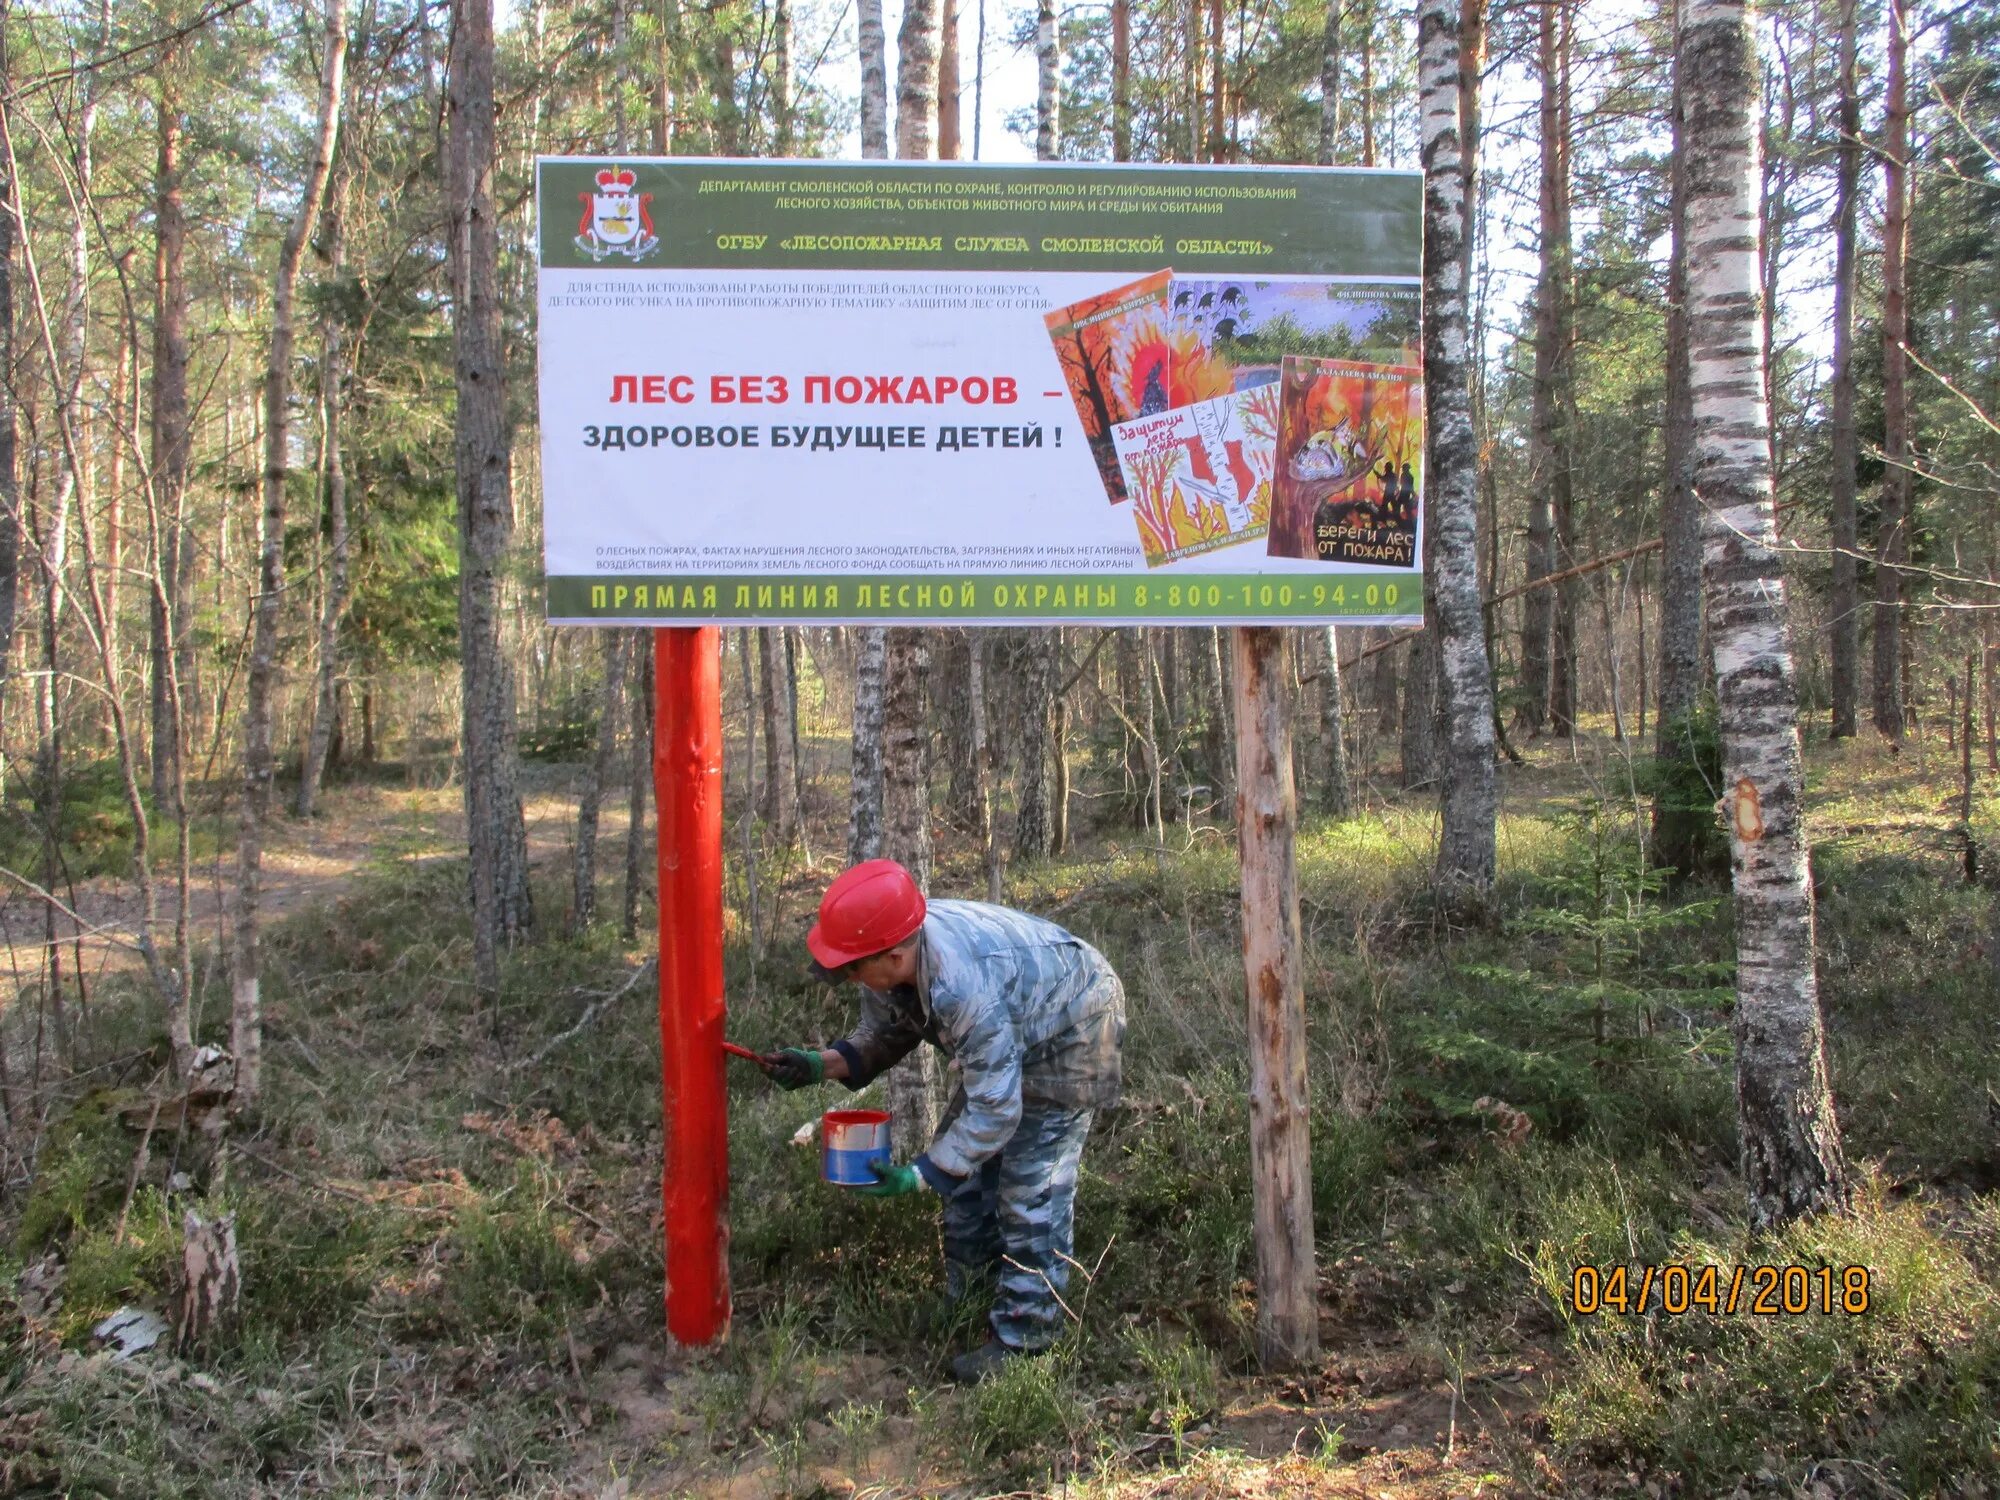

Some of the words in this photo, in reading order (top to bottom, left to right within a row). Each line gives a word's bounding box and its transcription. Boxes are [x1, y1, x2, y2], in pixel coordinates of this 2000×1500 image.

[699, 180, 785, 194] ДЕПАРТАМЕНТ
[790, 180, 873, 194] СМОЛЕНСКОЙ
[877, 182, 931, 194] ОБЛАСТИ
[935, 183, 951, 194] ПО
[955, 183, 1004, 196] ОХРАНЕ,
[1008, 184, 1074, 196] КОНТРОЛЮ
[1078, 185, 1086, 196] И
[1090, 185, 1191, 198] РЕГУЛИРОВАНИЮ
[1195, 187, 1296, 199] ИСПОЛЬЗОВАНИЯ
[775, 198, 829, 209] ЛЕСНОГО
[833, 197, 903, 211] ХОЗЯЙСТВА,
[908, 199, 969, 211] ОБЪЕКТОВ
[972, 200, 1047, 211] ЖИВОТНОГО
[1050, 200, 1084, 212] МИРА
[1088, 201, 1096, 211] И
[1099, 201, 1138, 213] СРЕДЫ
[1142, 202, 1157, 212] ИХ
[1160, 202, 1223, 213] ОБИТАНИЯ
[717, 235, 768, 250] ОГБУ
[780, 235, 942, 251] «ЛЕСОПОЖАРНАЯ
[955, 237, 1029, 252] СЛУЖБА
[1041, 234, 1164, 253] СМОЛЕНСКОЙ
[1176, 239, 1273, 255] ОБЛАСТИ»
[567, 283, 592, 293] ДЛЯ
[594, 283, 643, 293] СТЕНДА
[647, 283, 747, 293] ИСПОЛЬЗОВАНЫ
[750, 283, 798, 293] РАБОТЫ
[802, 282, 889, 295] ПОБЕДИТЕЛЕЙ
[893, 285, 973, 295] ОБЛАСТНОГО
[976, 285, 1040, 295] КОНКУРСА
[548, 297, 612, 307] ДЕТСКОГО
[615, 297, 672, 307] РИСУНКА
[676, 297, 694, 307] НА
[697, 297, 827, 308] ПРОТИВОПОЖАРНУЮ
[831, 299, 895, 308] ТЕМАТИКУ
[898, 299, 967, 309] «ЗАЩИТИМ
[970, 299, 993, 309] ЛЕС
[996, 299, 1012, 309] ОТ
[1015, 300, 1053, 309] ОГНЯ»
[610, 375, 694, 404] ЛЕС
[711, 375, 789, 404] БЕЗ
[804, 376, 1018, 404] ПОЖАРОВ
[583, 426, 758, 450] ЗДОРОВОЕ
[771, 426, 926, 451] БУДУЩЕЕ
[936, 422, 1044, 451] ДЕТЕЙ
[1118, 414, 1184, 440] Защитим
[596, 547, 604, 556] О
[606, 547, 646, 556] ЛЕСНЫХ
[649, 547, 699, 557] ПОЖАРАХ,
[702, 547, 740, 556] ФАКТАХ
[744, 547, 805, 556] НАРУШЕНИЯ
[807, 547, 852, 556] ЛЕСНОГО
[855, 546, 959, 557] ЗАКОНОДАТЕЛЬСТВА,
[962, 546, 1035, 556] ЗАГРЯЗНЕНИЯХ
[1037, 546, 1044, 556] И
[1046, 546, 1075, 556] ИНЫХ
[1077, 546, 1141, 556] НЕГАТИВНЫХ
[596, 559, 672, 569] ВОЗДЕЙСТВИЯХ
[675, 560, 689, 569] НА
[692, 560, 759, 569] ТЕРРИТОРИЯХ
[762, 560, 801, 569] ЗЕМЕЛЬ
[803, 560, 849, 569] ЛЕСНОГО
[851, 559, 887, 569] ФОНДА
[889, 559, 945, 569] СООБЩАТЬ
[947, 559, 961, 569] НА
[964, 559, 1008, 569] ПРЯМУЮ
[1010, 559, 1048, 569] ЛИНИЮ
[1050, 557, 1090, 569] ЛЕСНОЙ
[1092, 559, 1134, 569] ОХРАНЫ
[592, 585, 716, 608] ПРЯМАЯ
[735, 585, 839, 608] ЛИНИЯ
[856, 581, 975, 608] ЛЕСНОЙ
[994, 585, 1116, 608] ОХРАНЫ
[1135, 585, 1398, 607] 8-800-100-94-00
